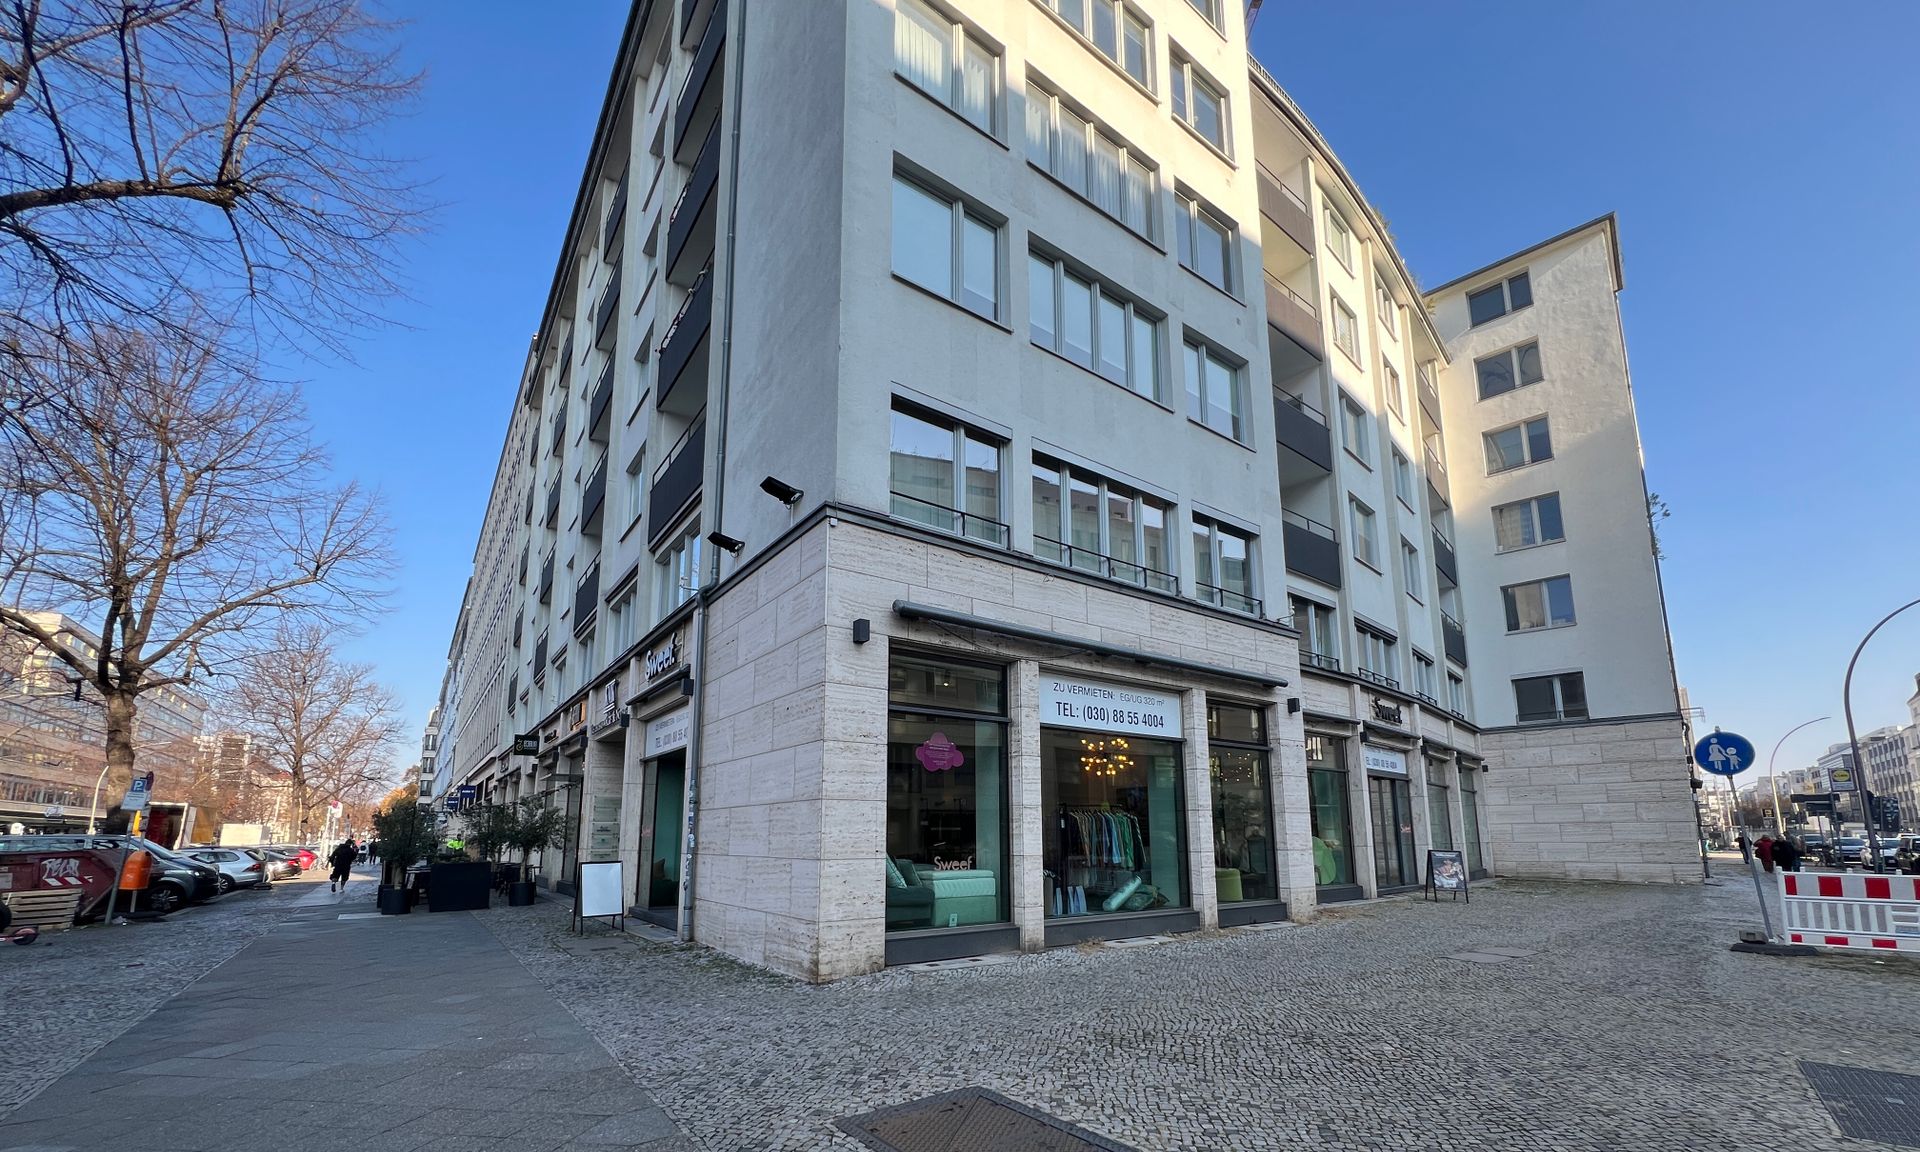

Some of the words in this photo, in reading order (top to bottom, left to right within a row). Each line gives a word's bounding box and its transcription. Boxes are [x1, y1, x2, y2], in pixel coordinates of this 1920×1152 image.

[1053, 683, 1065, 692] ZU
[1067, 684, 1115, 700] VERMIETEN:
[1120, 693, 1142, 704] EG/UG
[1143, 697, 1155, 706] 320
[1056, 702, 1079, 718] TEL:
[1083, 704, 1110, 725] (030)
[1112, 709, 1125, 724] 88
[1128, 711, 1139, 725] 55
[1142, 714, 1164, 728] 4004
[133, 780, 143, 791] P
